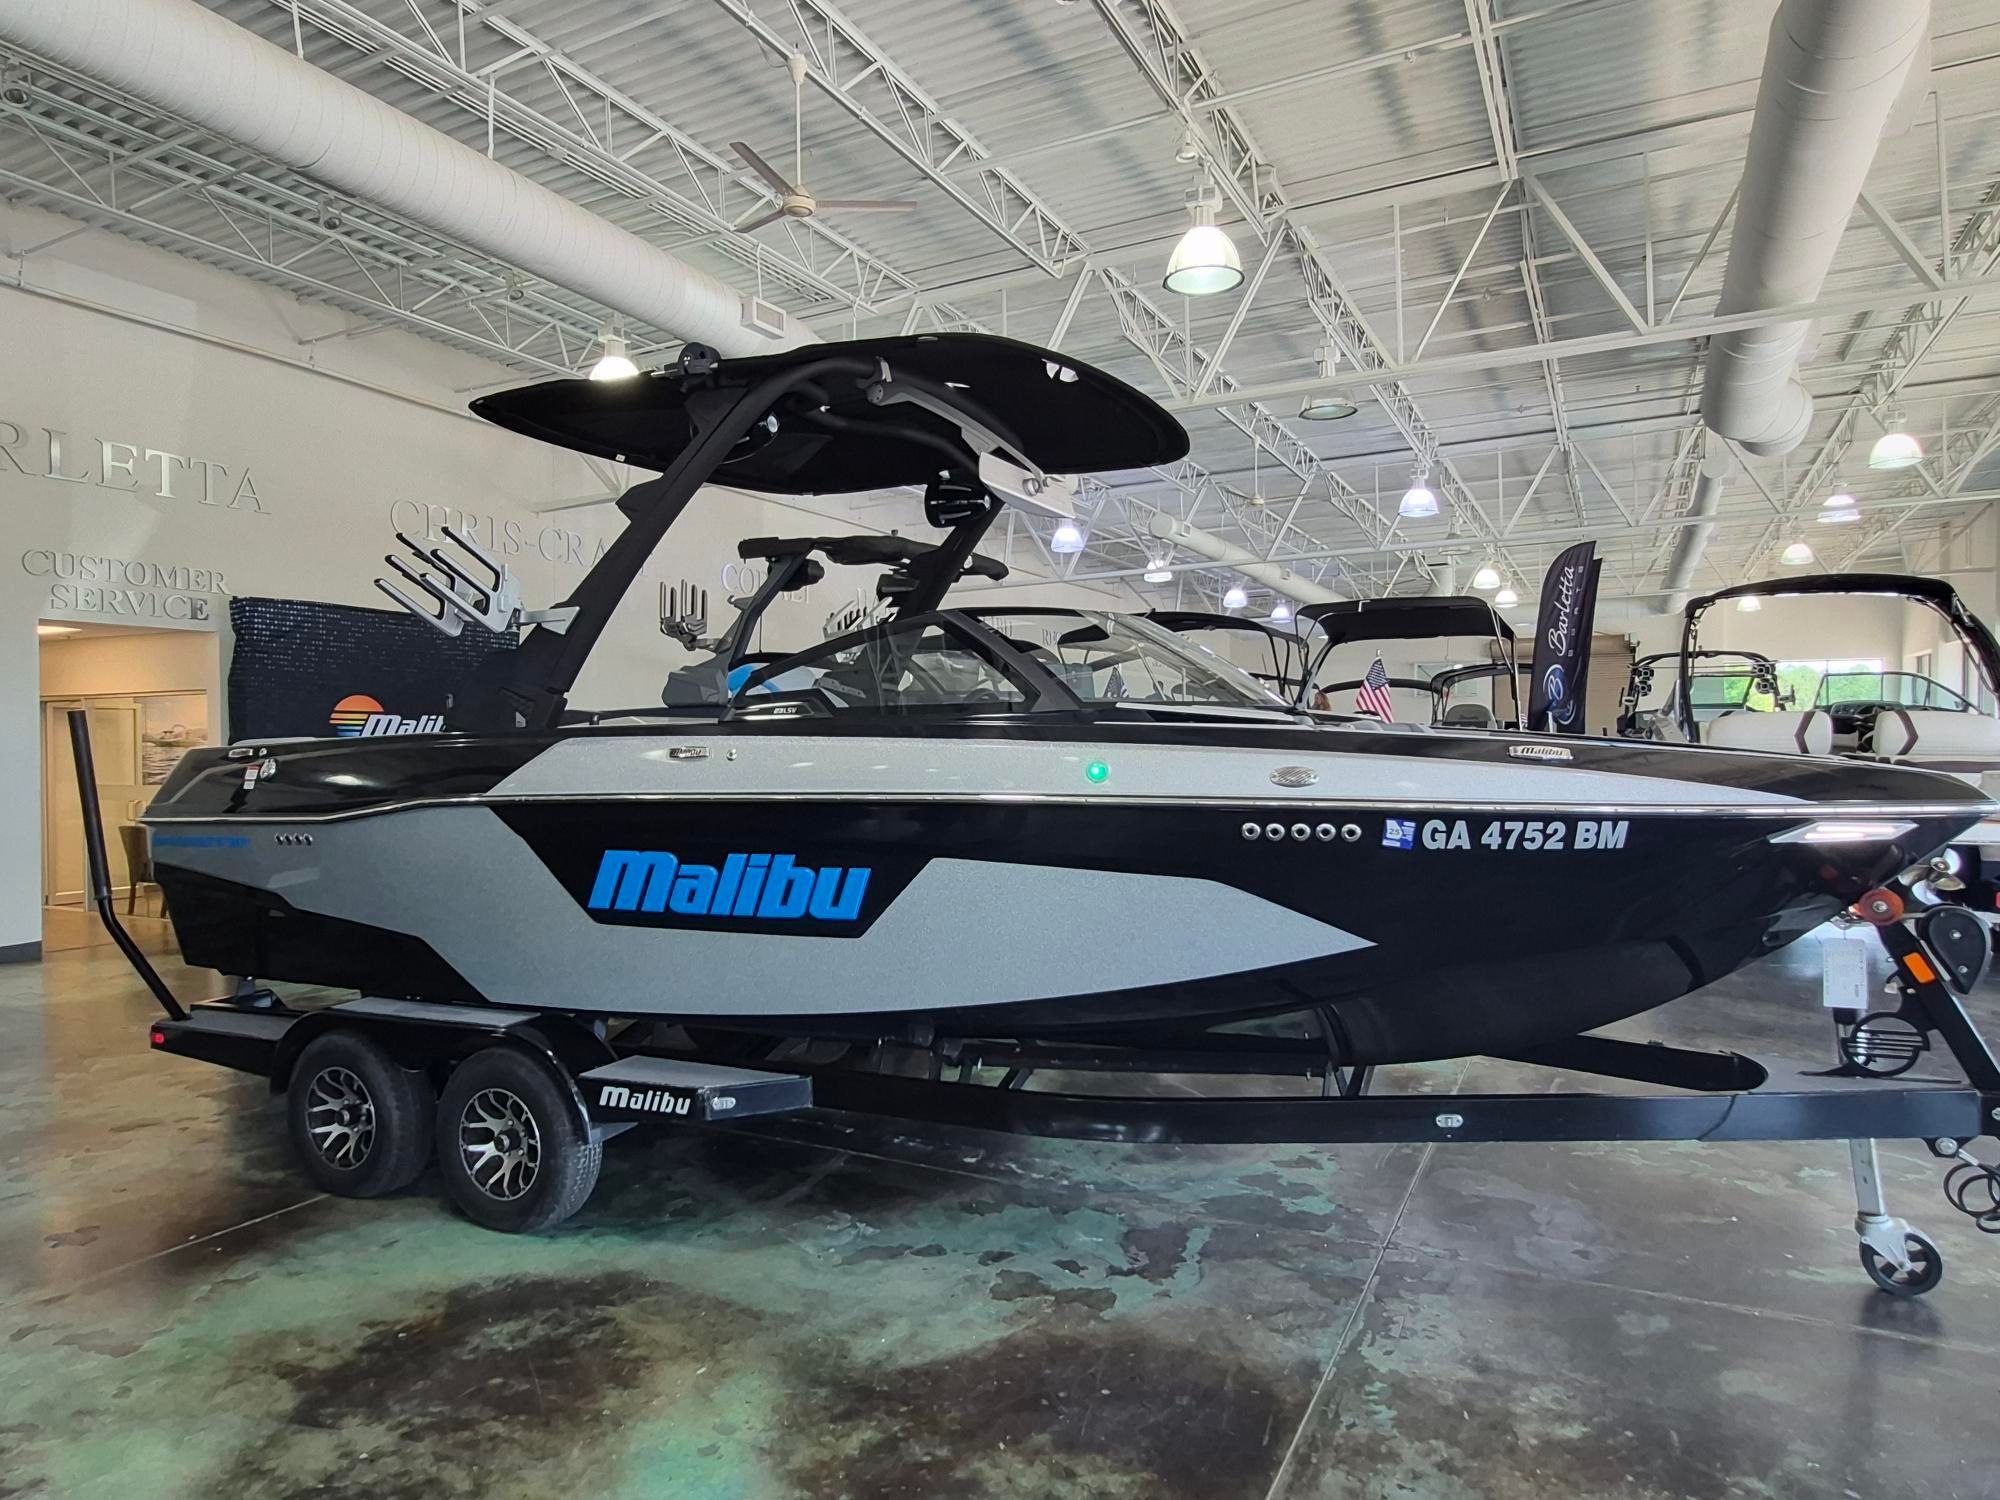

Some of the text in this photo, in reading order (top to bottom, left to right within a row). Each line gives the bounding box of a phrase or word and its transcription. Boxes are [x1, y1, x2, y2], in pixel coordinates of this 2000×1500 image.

[21, 550, 231, 595] CUSTOMER
[50, 583, 209, 621] SERVICE
[1548, 565, 1575, 657] Barletta
[1421, 819, 1471, 850] GA
[1480, 820, 1566, 850] 4752
[1574, 820, 1630, 850] BM
[587, 850, 872, 920] Malibu
[599, 1085, 691, 1116] Malibu
